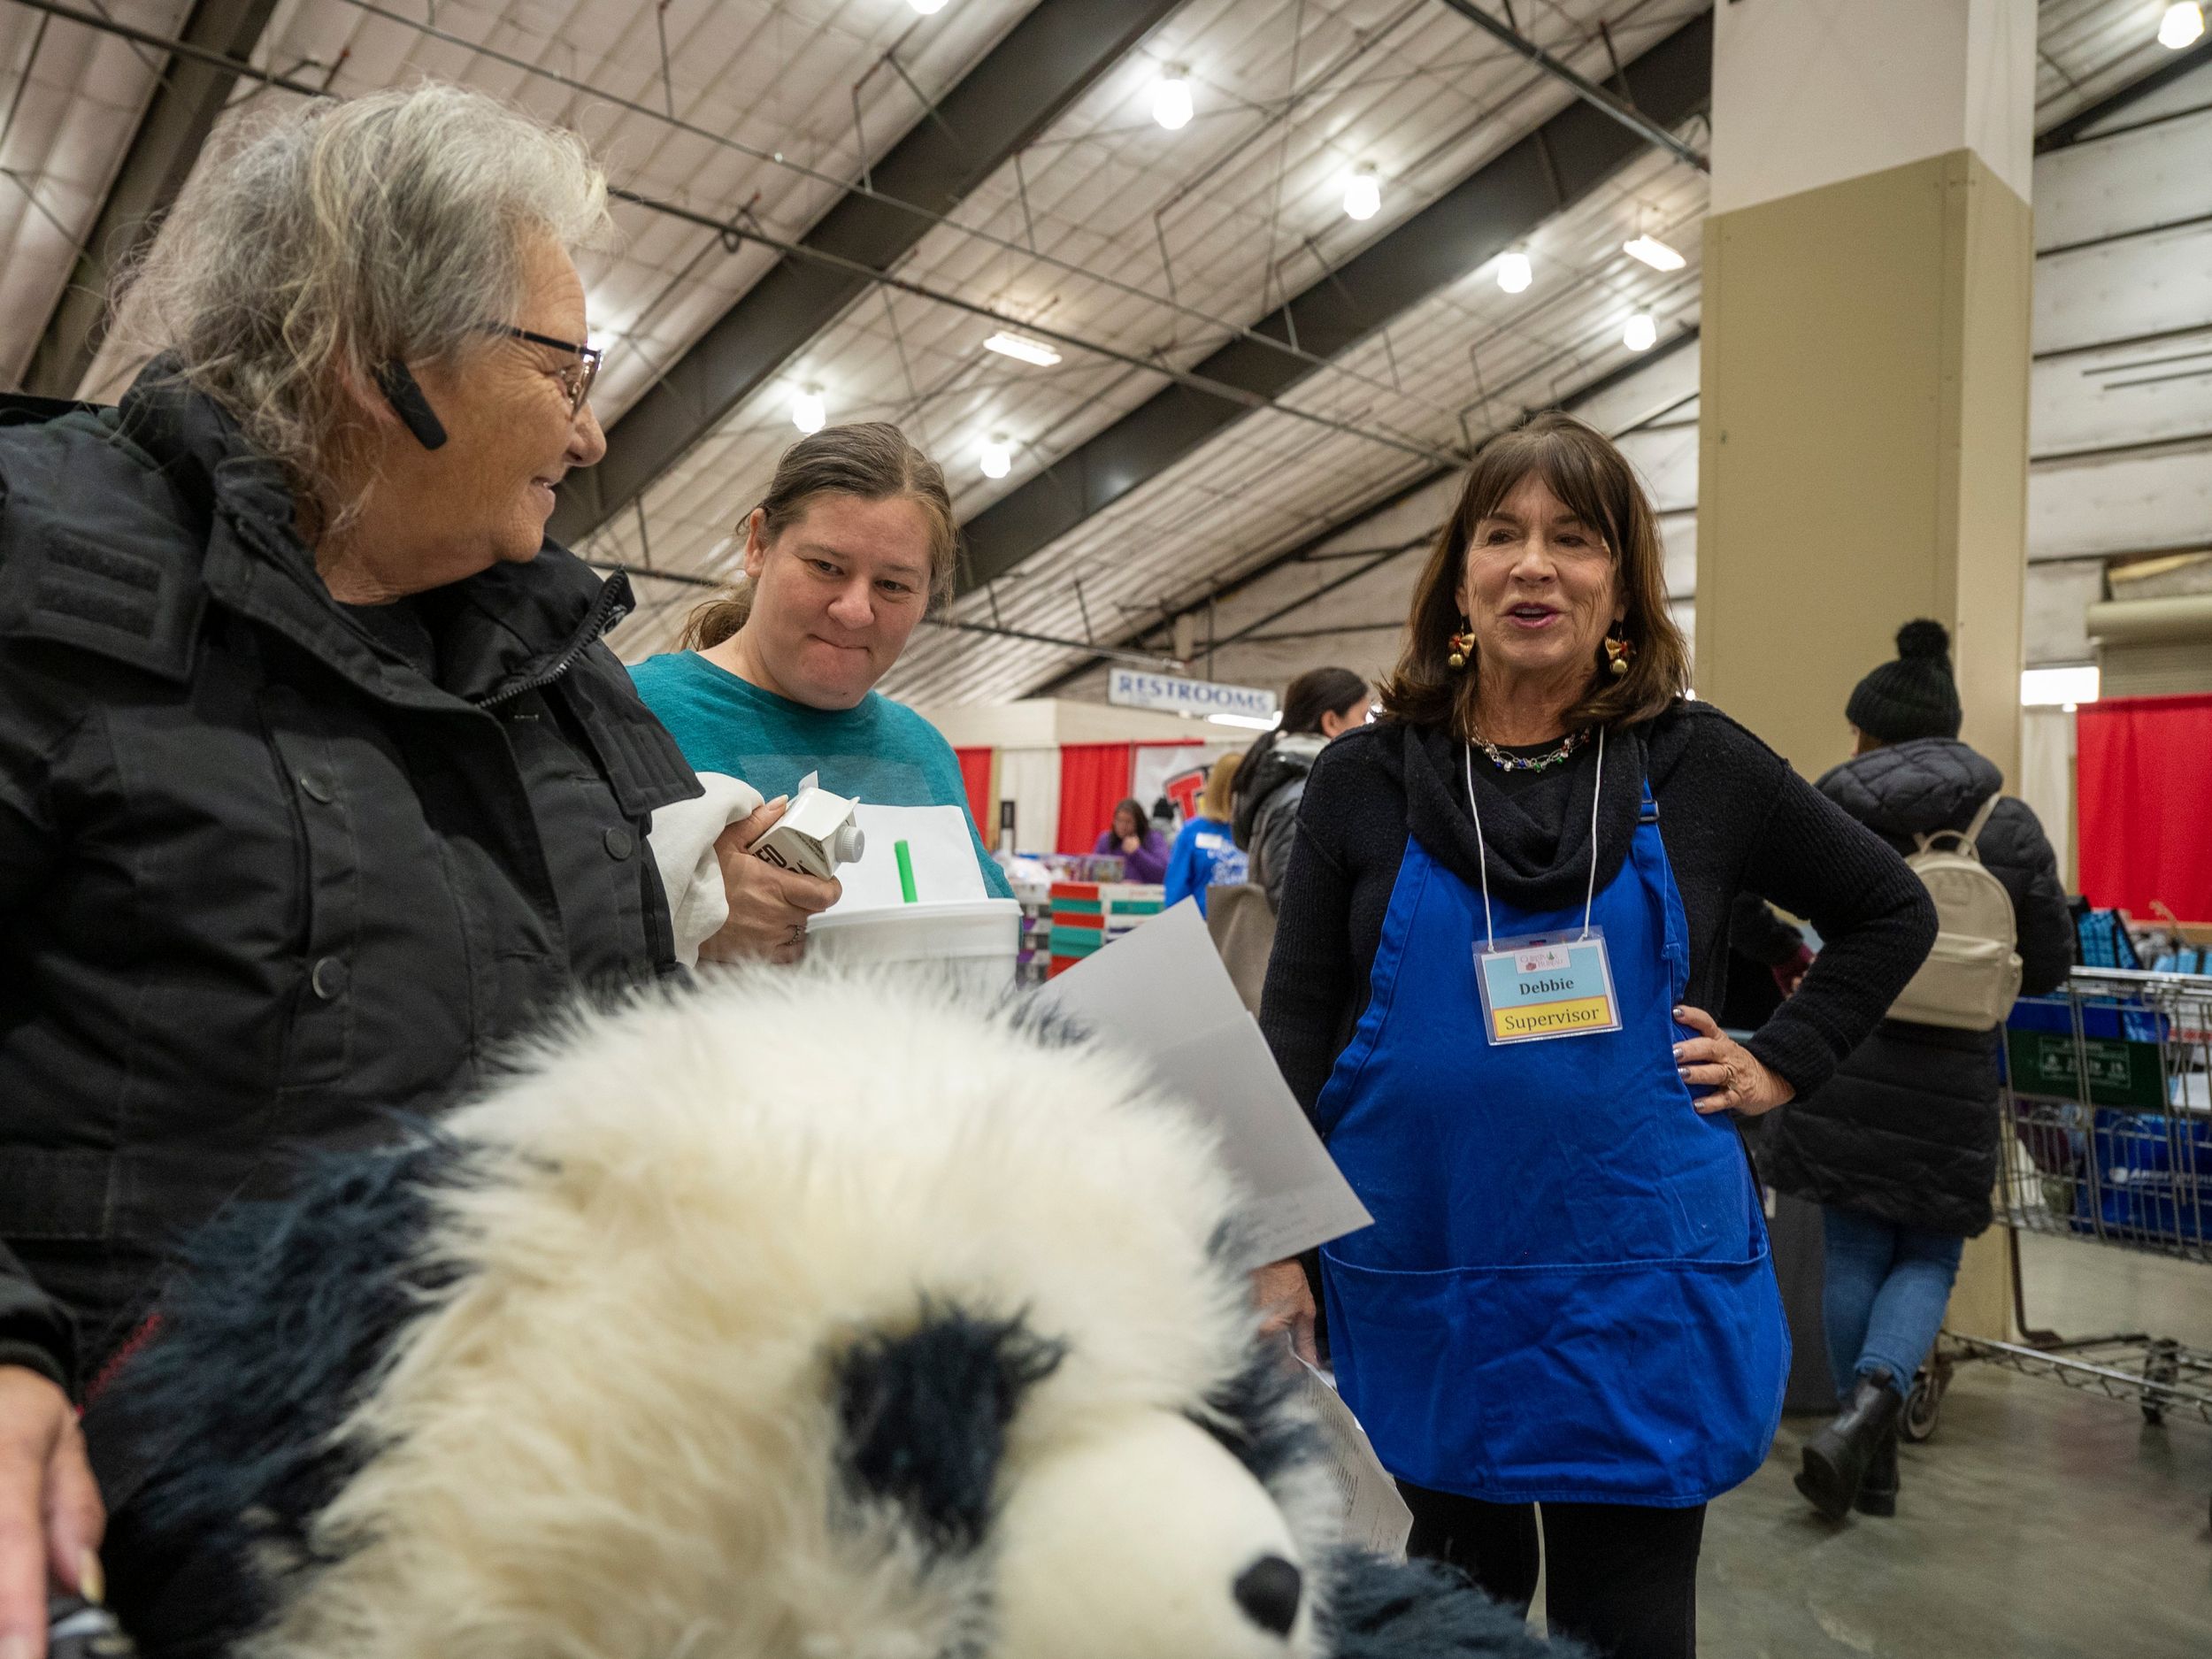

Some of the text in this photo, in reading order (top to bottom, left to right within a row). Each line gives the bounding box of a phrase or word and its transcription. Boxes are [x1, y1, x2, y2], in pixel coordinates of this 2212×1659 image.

[1118, 674, 1268, 710] RESTROOMS
[1519, 978, 1574, 995] Debbie
[1505, 1009, 1599, 1031] Supervisor
